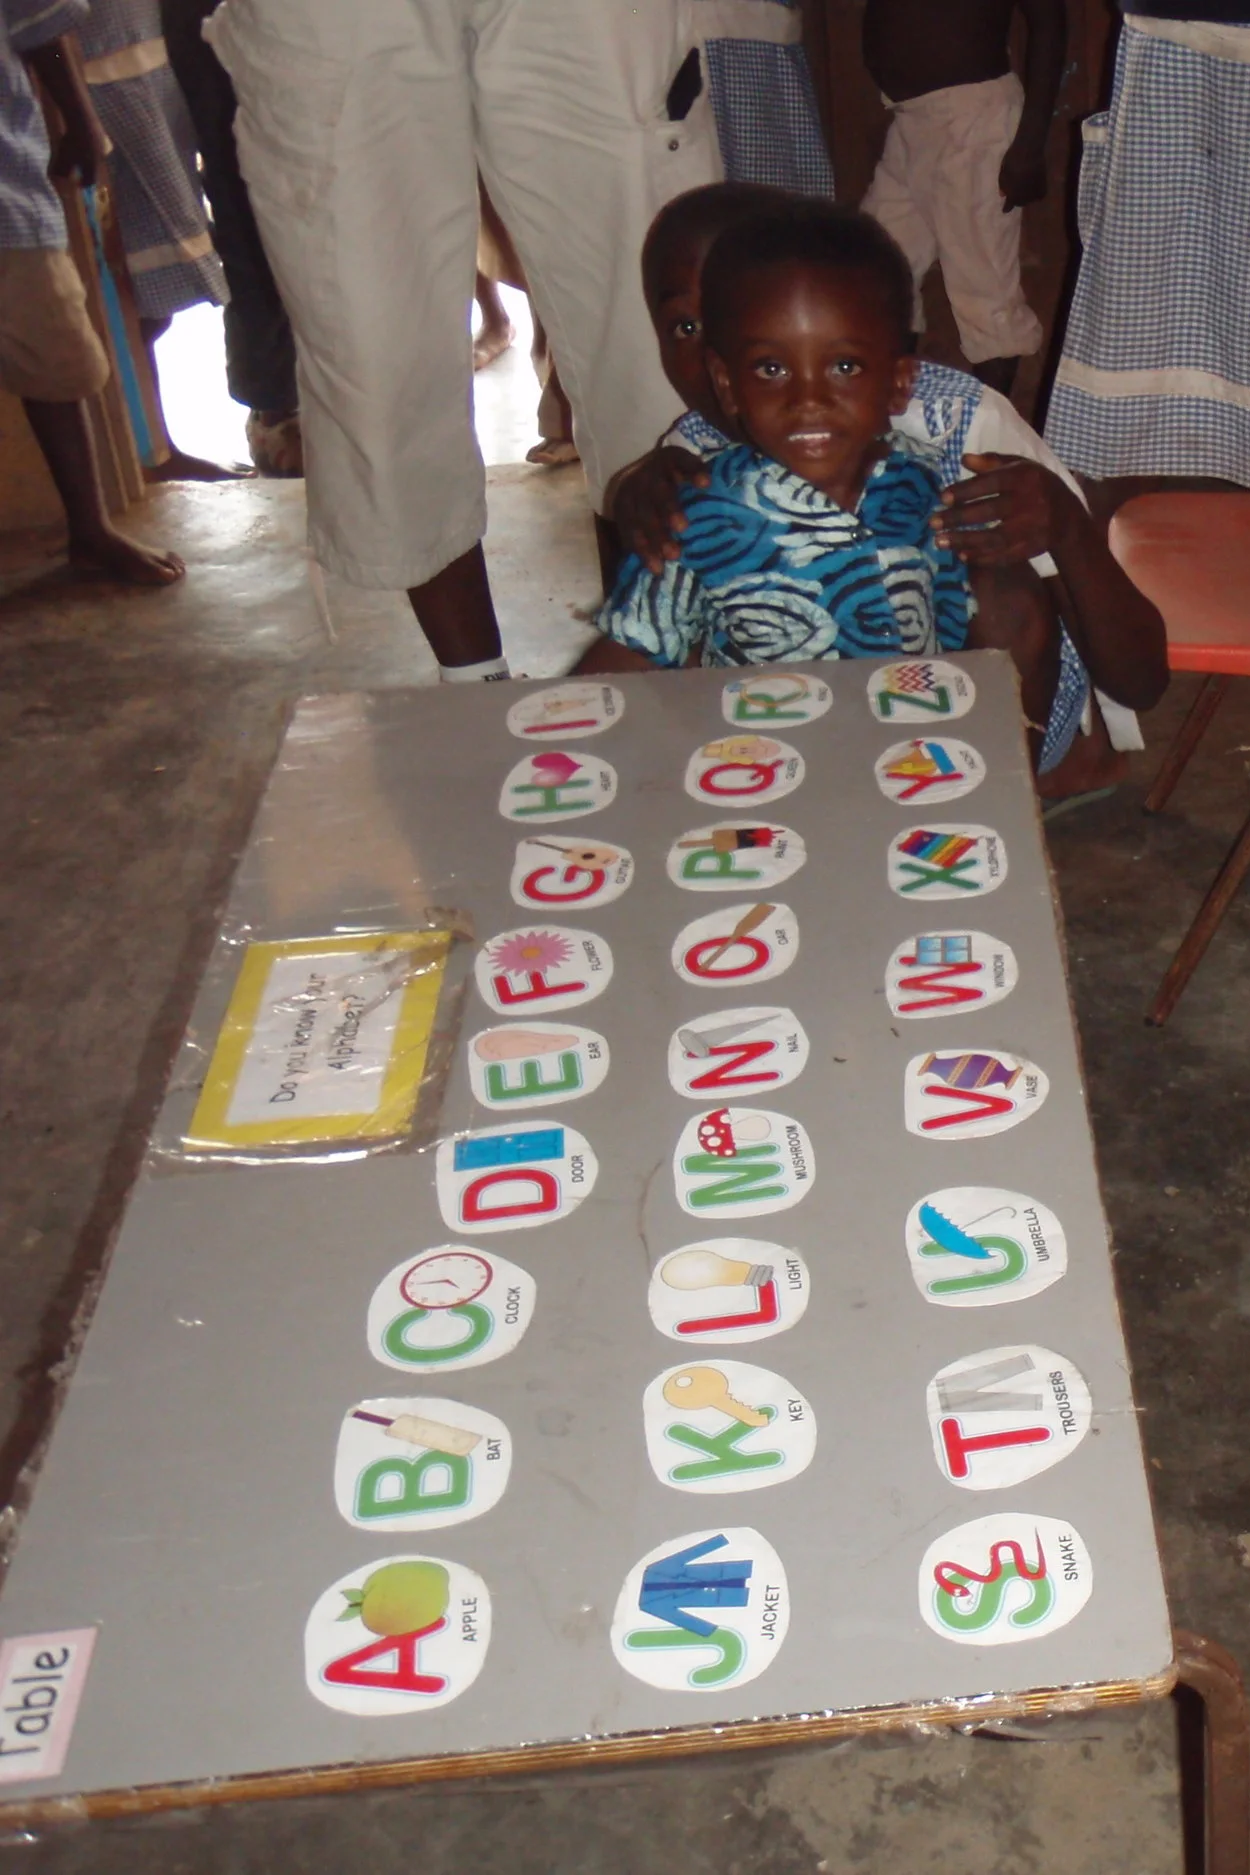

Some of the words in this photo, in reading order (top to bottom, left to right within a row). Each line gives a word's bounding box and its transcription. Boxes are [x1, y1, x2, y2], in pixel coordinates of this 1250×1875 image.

[734, 692, 812, 720] R
[879, 686, 950, 716] Z
[599, 771, 611, 792] HEART
[700, 760, 784, 796] Q
[785, 758, 799, 780] QUEEN
[886, 773, 964, 799] Y
[512, 779, 594, 816] H
[682, 850, 762, 879] P
[774, 839, 788, 859] PAINT
[985, 837, 1000, 878] XYLOPHONE
[523, 864, 605, 904] G
[614, 858, 630, 884] GUITAR
[898, 859, 979, 891] X
[582, 940, 602, 971] FLOWER
[775, 929, 788, 945] OAR
[685, 936, 769, 978] O
[993, 954, 1005, 988] WINDOW
[302, 973, 326, 1005] your
[493, 971, 586, 1005] F
[899, 957, 983, 1011] W
[285, 1009, 317, 1048] know
[787, 1032, 799, 1053] NAIL
[282, 1051, 308, 1077] you
[589, 1042, 600, 1060] EAR
[687, 1041, 779, 1089] N
[269, 1081, 298, 1103] Do
[487, 1051, 580, 1102] E
[1026, 1076, 1039, 1099] VASE
[923, 1086, 1012, 1129] V
[571, 1153, 586, 1184] DOOR
[788, 1125, 806, 1181] MUSHROOM
[463, 1169, 557, 1221] D
[683, 1145, 786, 1207] M
[1023, 1207, 1050, 1262] UMBRELLA
[786, 1257, 801, 1291] LIGHT
[921, 1235, 1025, 1292] U
[504, 1286, 521, 1325] CLOCK
[677, 1280, 778, 1334] L
[386, 1303, 491, 1363] C
[788, 1397, 803, 1422] KEY
[1051, 1371, 1078, 1437] TROUSERS
[486, 1437, 501, 1461] BAT
[669, 1405, 782, 1479] K
[942, 1418, 1050, 1478] T
[358, 1448, 470, 1518] B
[1059, 1534, 1078, 1581] SNAKE
[759, 1583, 781, 1642] JACKET
[937, 1561, 1054, 1629] S
[462, 1596, 479, 1643] APPLE
[324, 1618, 445, 1693] A
[627, 1626, 742, 1685] J
